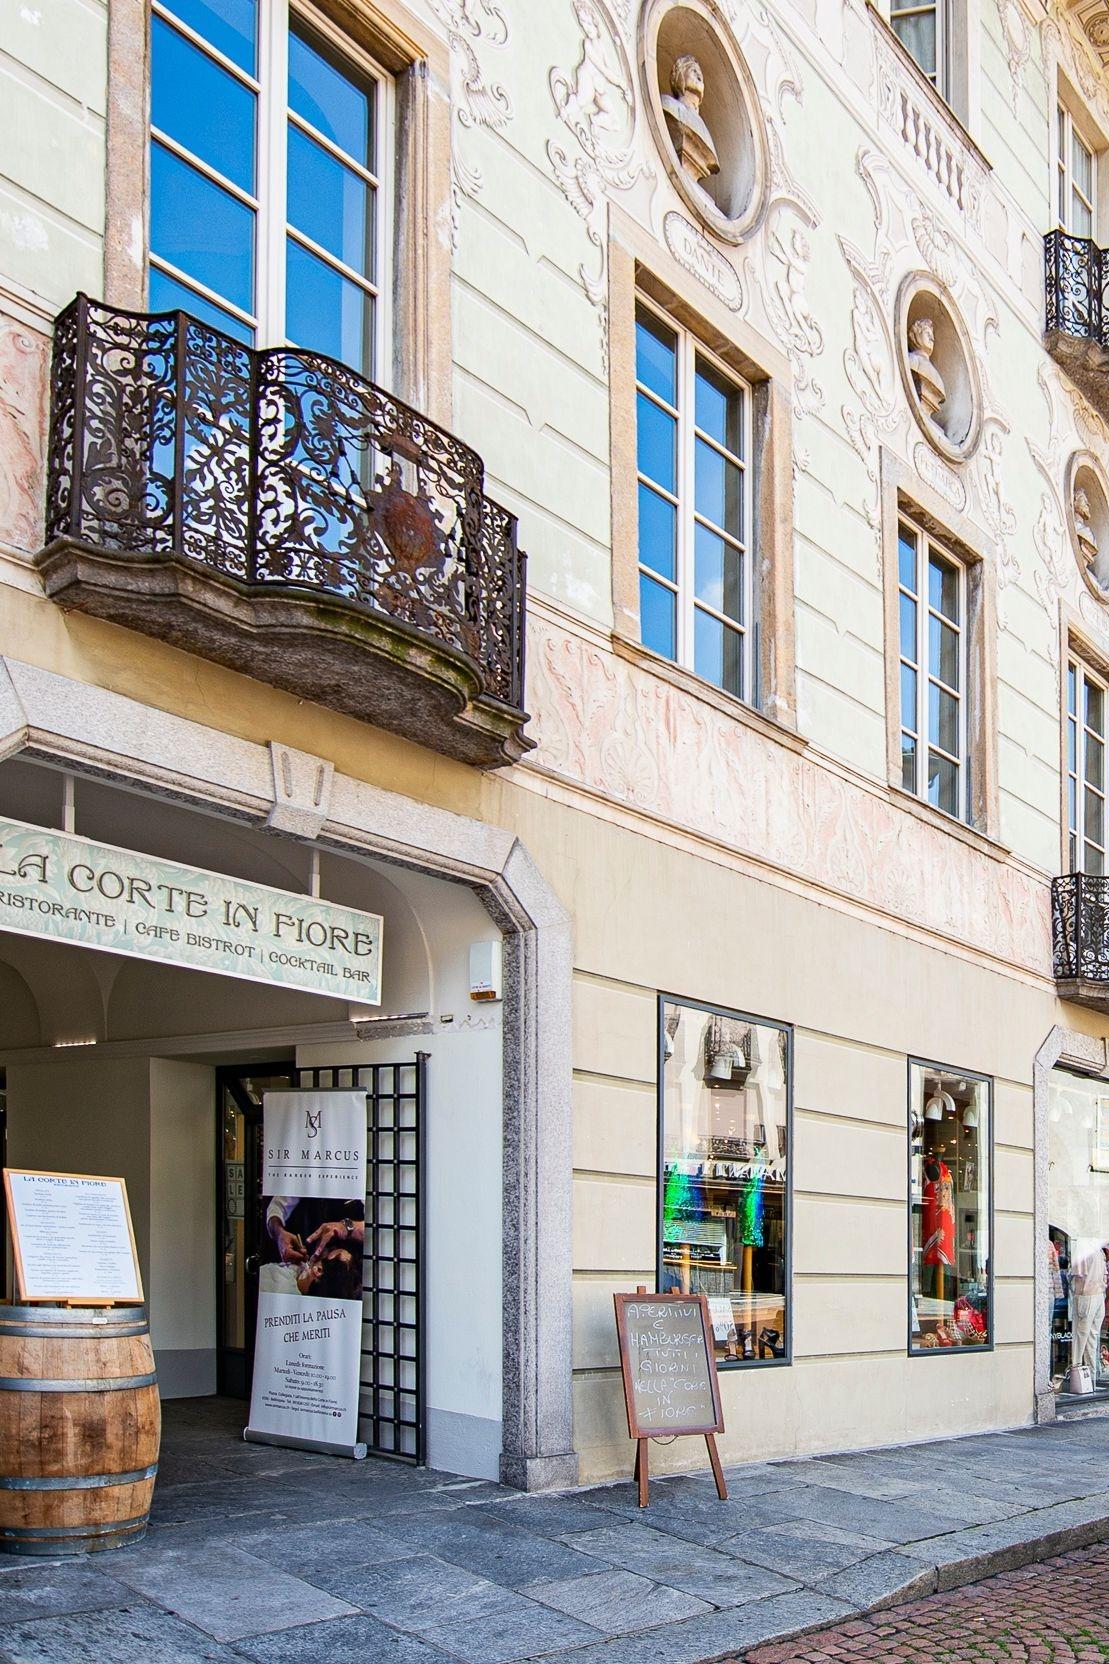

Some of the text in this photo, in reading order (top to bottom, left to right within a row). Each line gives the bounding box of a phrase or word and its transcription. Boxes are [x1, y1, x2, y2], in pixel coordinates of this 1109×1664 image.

[69, 864, 208, 917] CORTE
[223, 900, 259, 932] IN
[273, 912, 373, 956] FIORE
[186, 932, 256, 958] BISTROT
[268, 951, 338, 976] COCKTAIL
[342, 968, 372, 984] BAR
[268, 1149, 359, 1161] SIR MARCUS
[264, 1308, 346, 1328] PRENDITI LA PAUSA
[283, 1327, 331, 1343] CHE MERITI
[657, 1390, 674, 1406] IN
